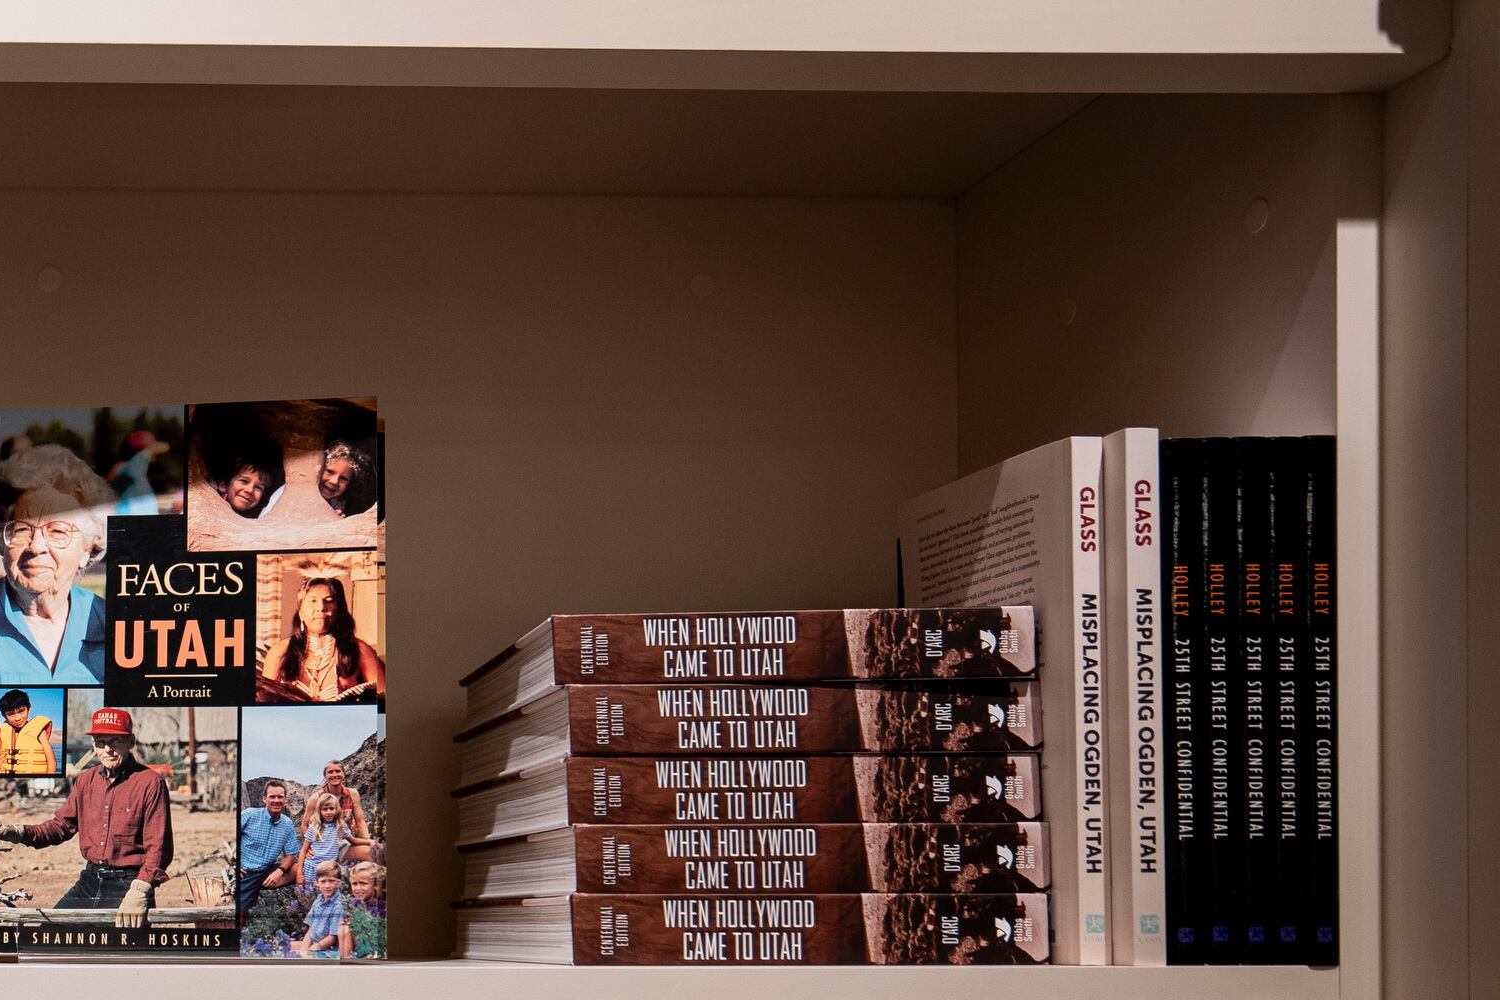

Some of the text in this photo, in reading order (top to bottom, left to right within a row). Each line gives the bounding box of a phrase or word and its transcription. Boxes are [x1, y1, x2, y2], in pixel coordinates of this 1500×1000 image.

[1134, 479, 1152, 546] GLASS
[117, 561, 243, 596] FACES
[1210, 564, 1225, 614] HOLLEY
[173, 603, 190, 612] OF
[113, 618, 244, 668] UTAH
[643, 616, 796, 646] WHEN HOLLYWOOD
[925, 629, 943, 657] D'ARC
[999, 630, 1008, 653] Gibbs
[1008, 630, 1018, 653] Smith
[579, 625, 594, 677] CENTENNIAL
[595, 632, 609, 668] EDITION
[663, 648, 783, 678] CAME TO UTAH
[147, 685, 212, 698] A Portrait
[1136, 588, 1157, 873] MISPLACING OGDEN, UTAH
[1211, 637, 1228, 839] 25TH STREET CONFIDENTIAL
[3, 932, 20, 944] BY
[32, 932, 108, 945] SHANNON
[121, 933, 135, 945] R.
[149, 933, 220, 947] HOSKINS
